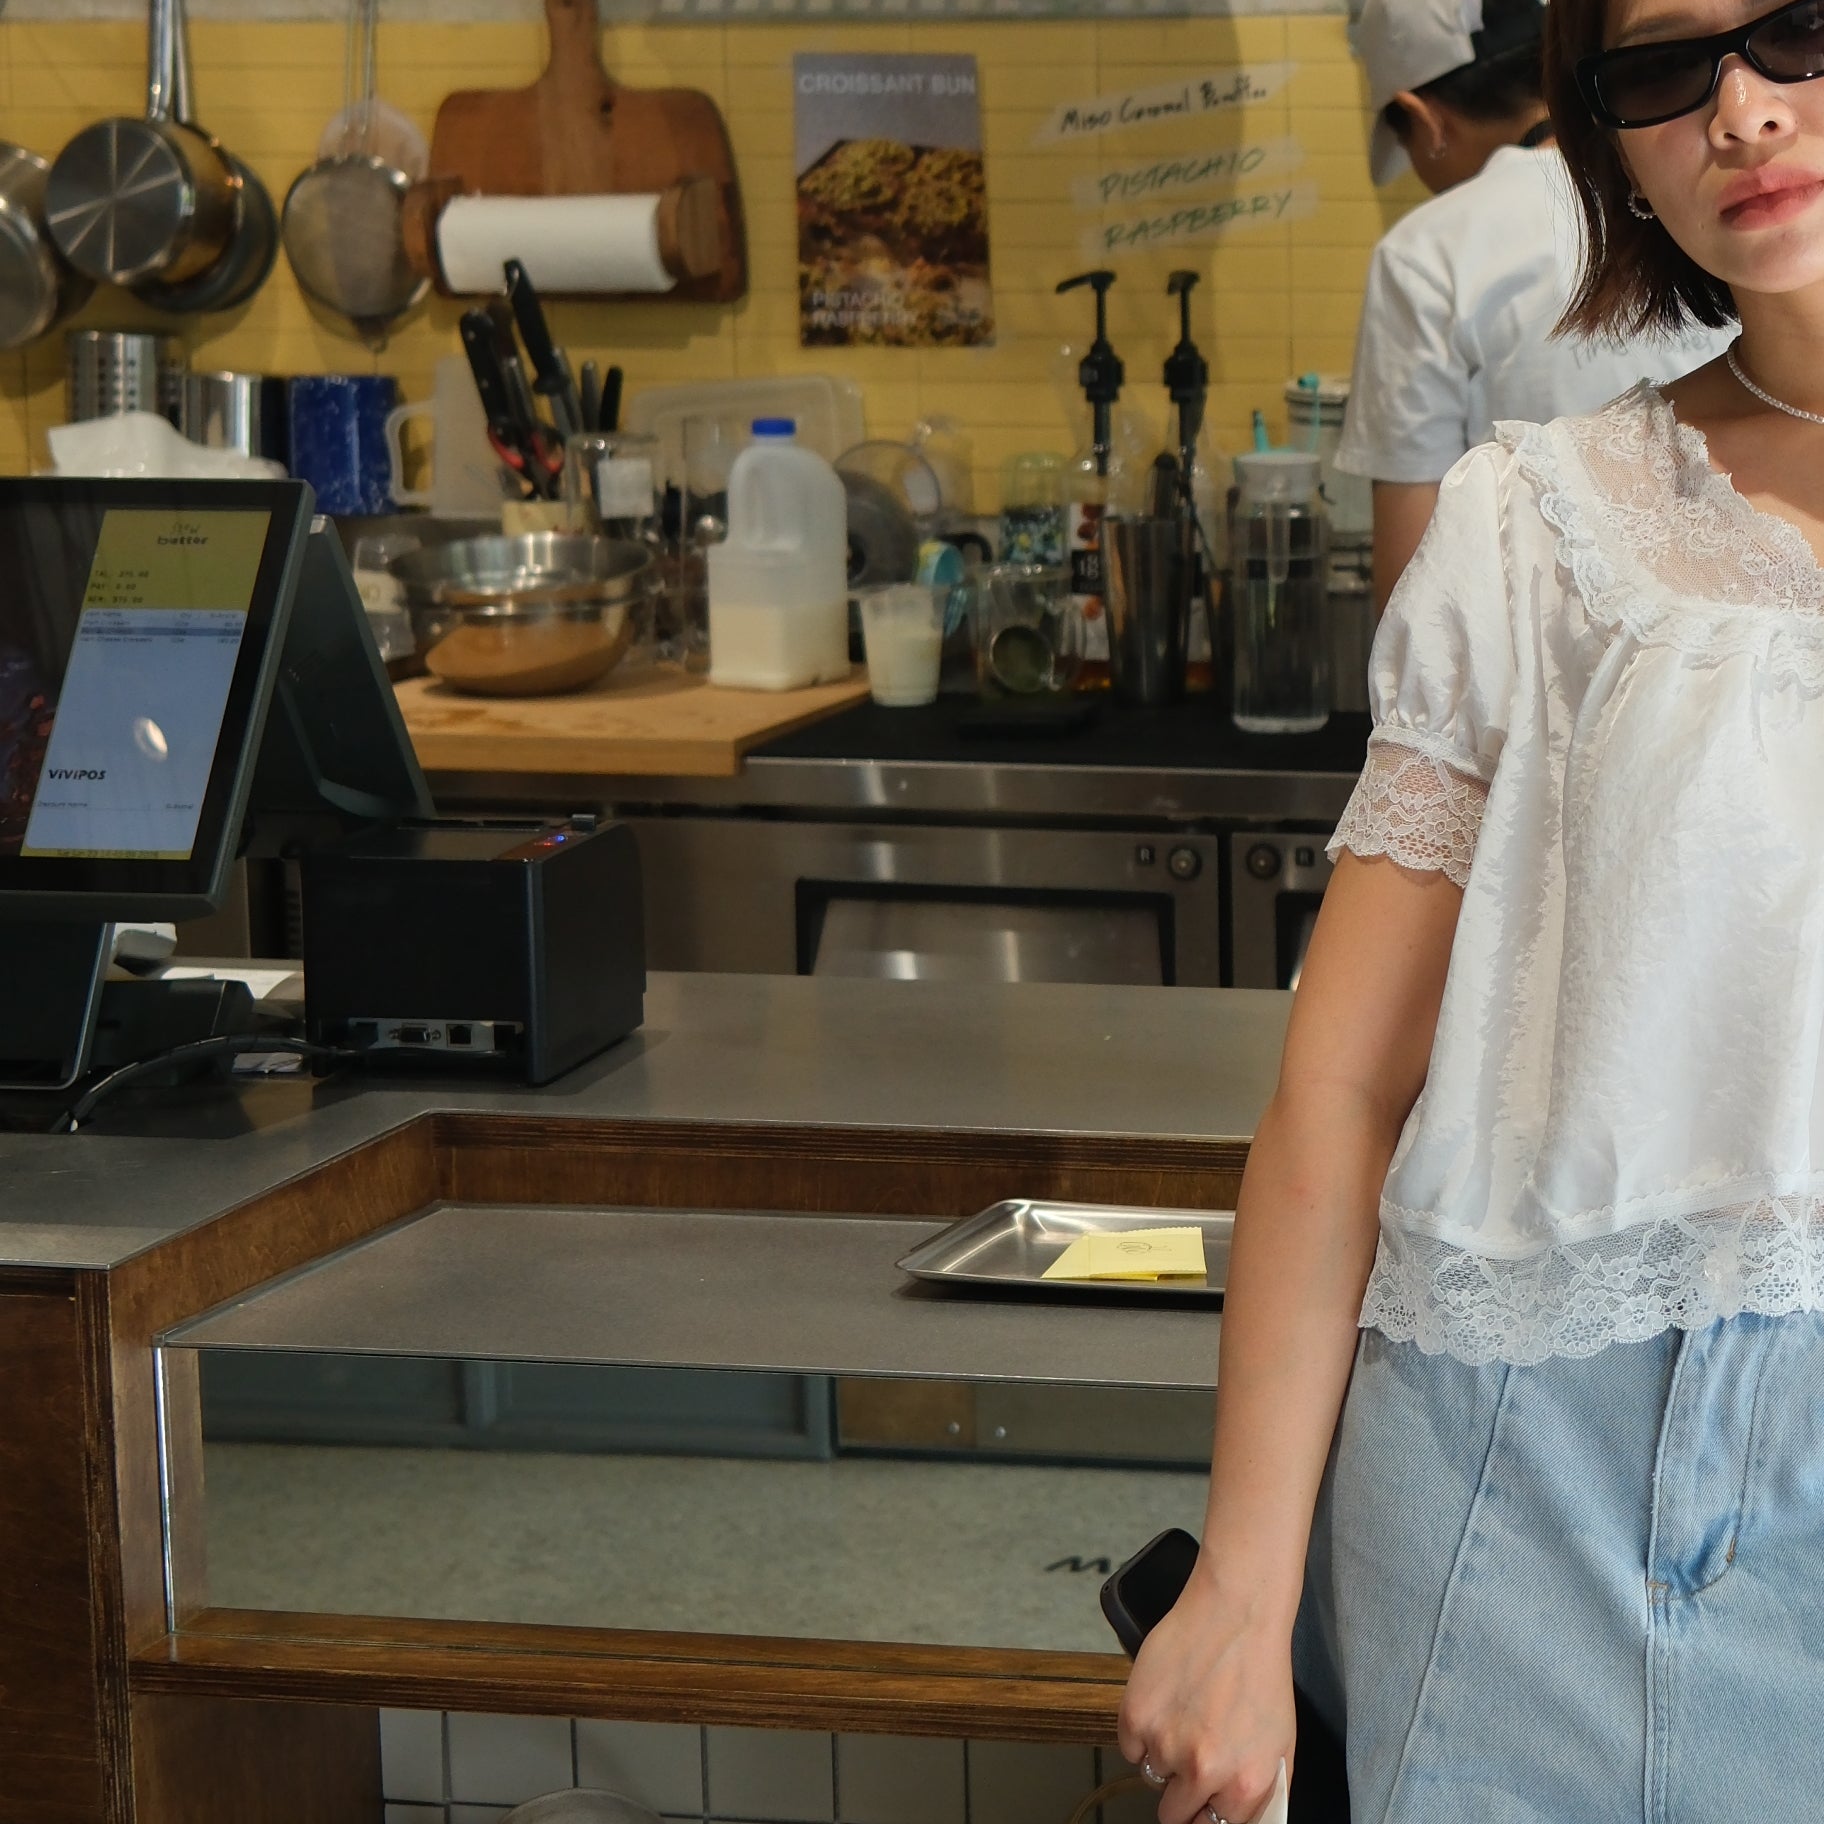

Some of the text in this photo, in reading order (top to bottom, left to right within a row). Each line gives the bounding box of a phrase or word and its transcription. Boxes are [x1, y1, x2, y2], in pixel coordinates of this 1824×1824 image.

[800, 73, 976, 96] CROISSANT BUN
[1100, 147, 1267, 205] PISTACHIO
[1103, 189, 1293, 249] RASPBERRY
